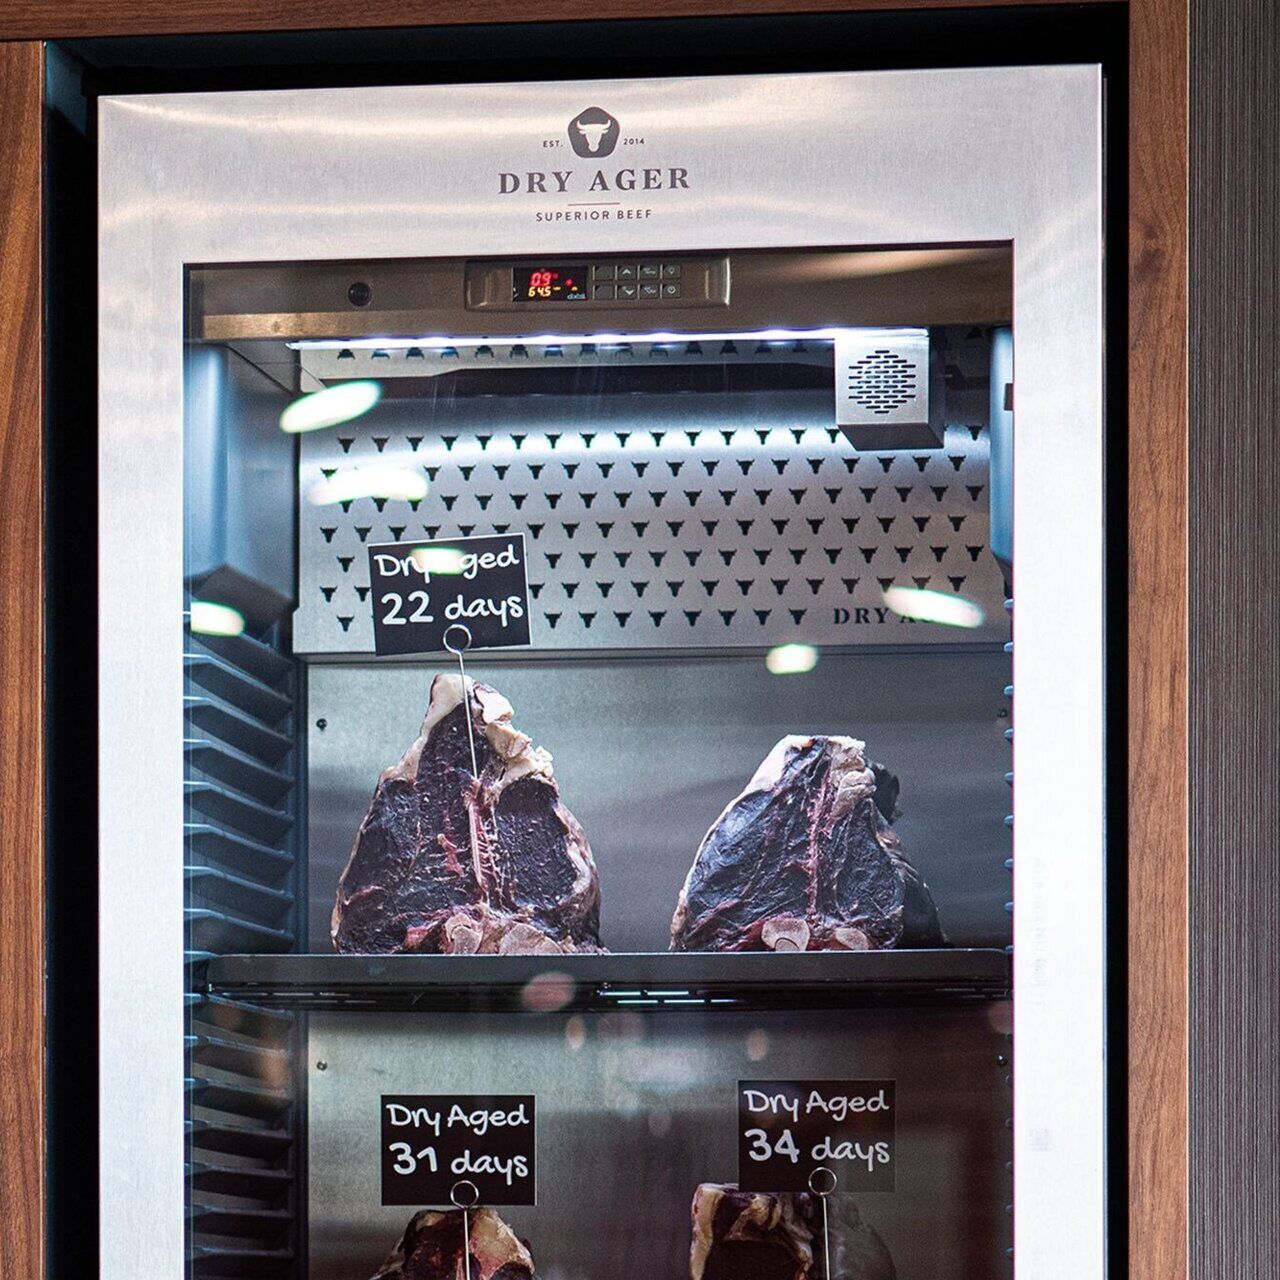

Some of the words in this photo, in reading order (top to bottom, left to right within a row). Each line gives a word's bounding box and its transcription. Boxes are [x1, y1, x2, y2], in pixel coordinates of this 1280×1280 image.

[543, 140, 563, 148] EST.
[499, 171, 572, 193] DRY
[589, 168, 689, 191] AGER
[536, 211, 609, 222] SUPERIOR
[618, 210, 651, 219] BEEF
[456, 544, 520, 579] ged
[382, 591, 433, 624] 22
[444, 594, 524, 627] days
[834, 608, 888, 624] DRY
[386, 1104, 440, 1136] Dry
[448, 1104, 529, 1135] Aged
[744, 1090, 798, 1122] Dry
[806, 1090, 889, 1121] Aged
[389, 1143, 437, 1174] 31
[450, 1151, 529, 1185] days
[745, 1129, 799, 1163] 34
[811, 1136, 891, 1171] days
